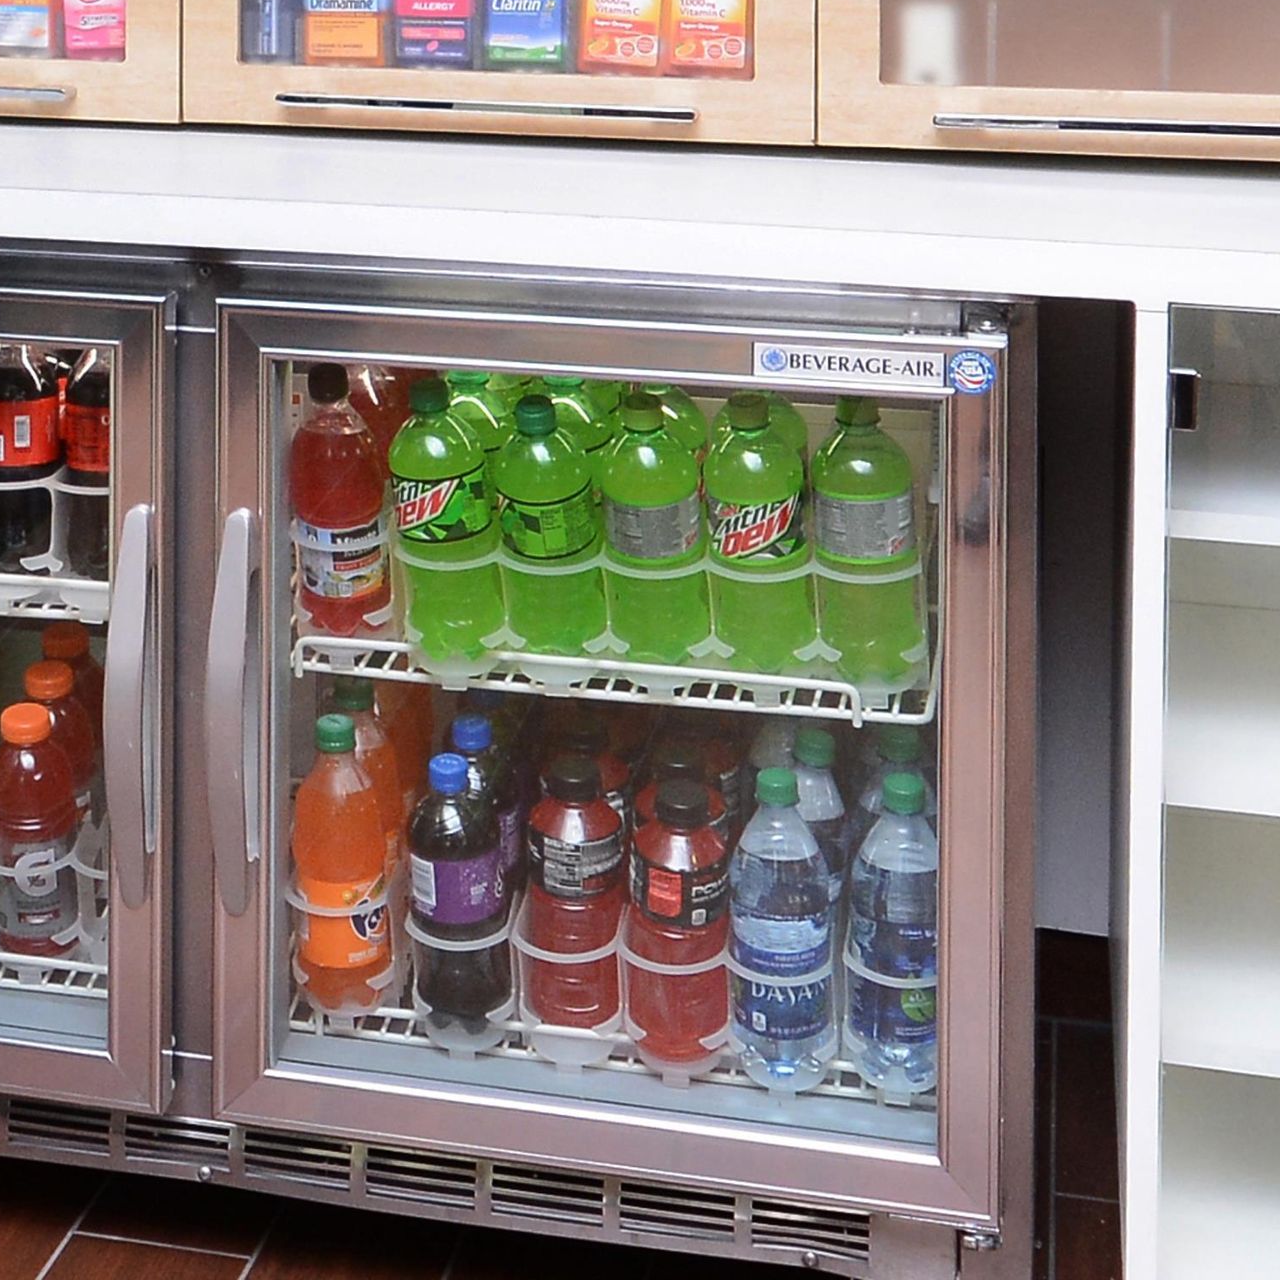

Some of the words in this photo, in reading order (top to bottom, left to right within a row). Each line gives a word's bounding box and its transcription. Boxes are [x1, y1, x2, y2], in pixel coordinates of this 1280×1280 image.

[411, 2, 457, 11] ALLERGY
[594, 5, 632, 15] Vitamin
[633, 8, 641, 17] C
[679, 7, 718, 17] Vitamin
[719, 9, 727, 18] C
[789, 354, 935, 377] BEVERAGE-AIR
[751, 978, 825, 1005] DASAN
